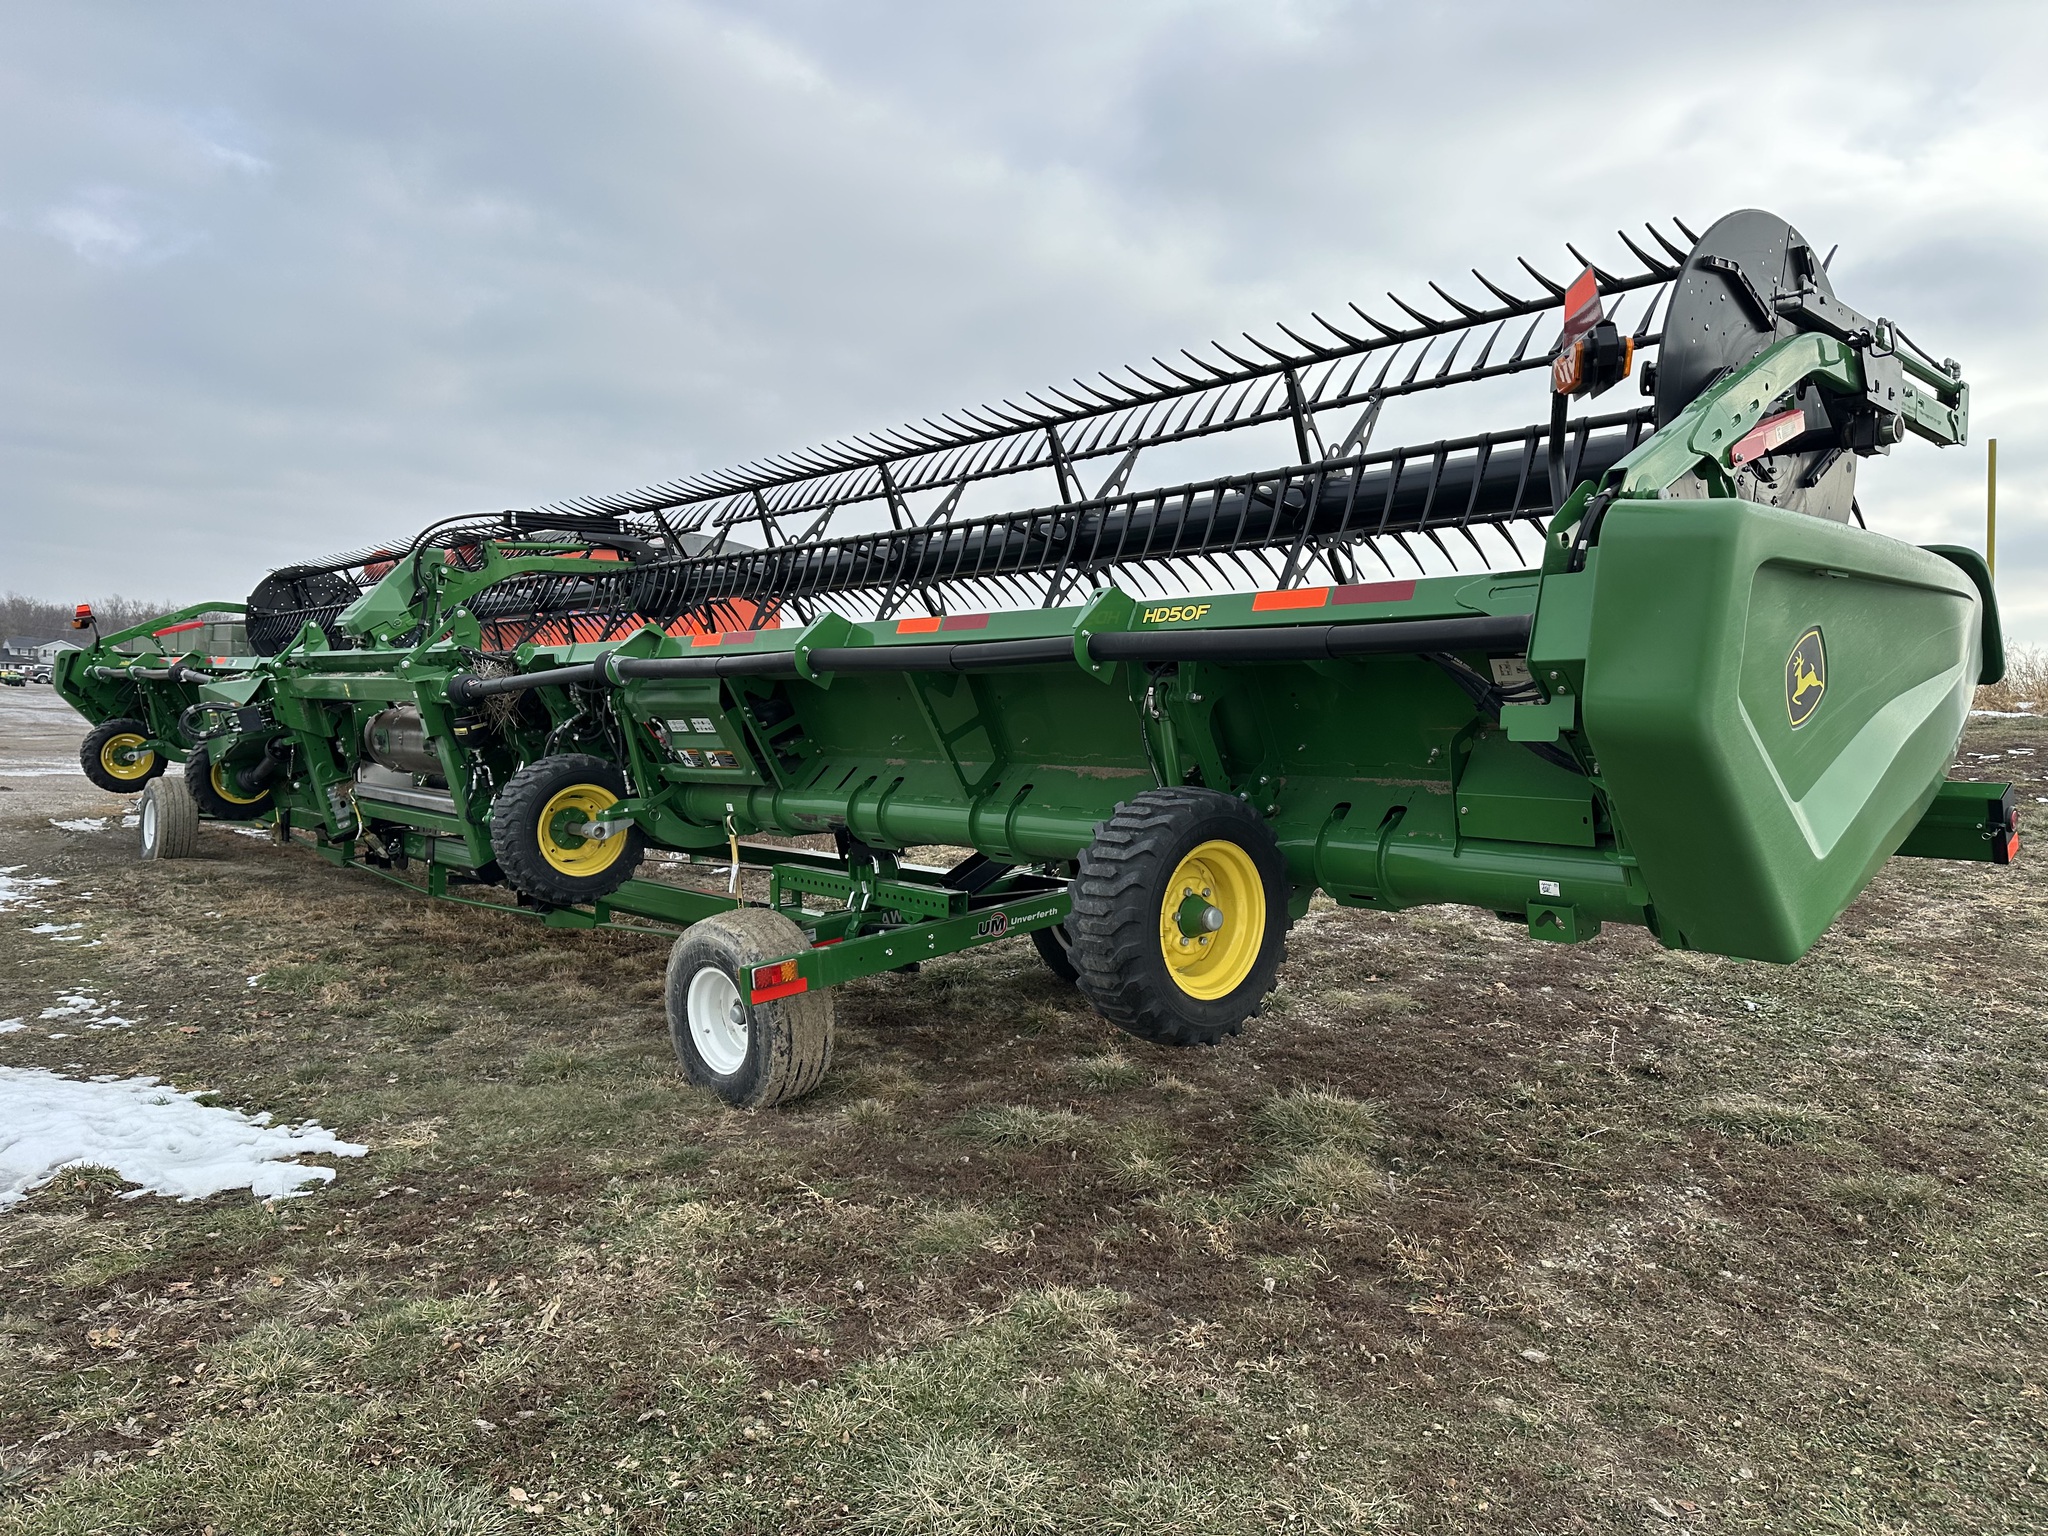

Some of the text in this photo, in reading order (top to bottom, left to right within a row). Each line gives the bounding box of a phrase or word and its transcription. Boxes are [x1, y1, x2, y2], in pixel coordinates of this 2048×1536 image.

[1142, 604, 1212, 624] HD50F
[978, 907, 1058, 936] UM Unverferth
